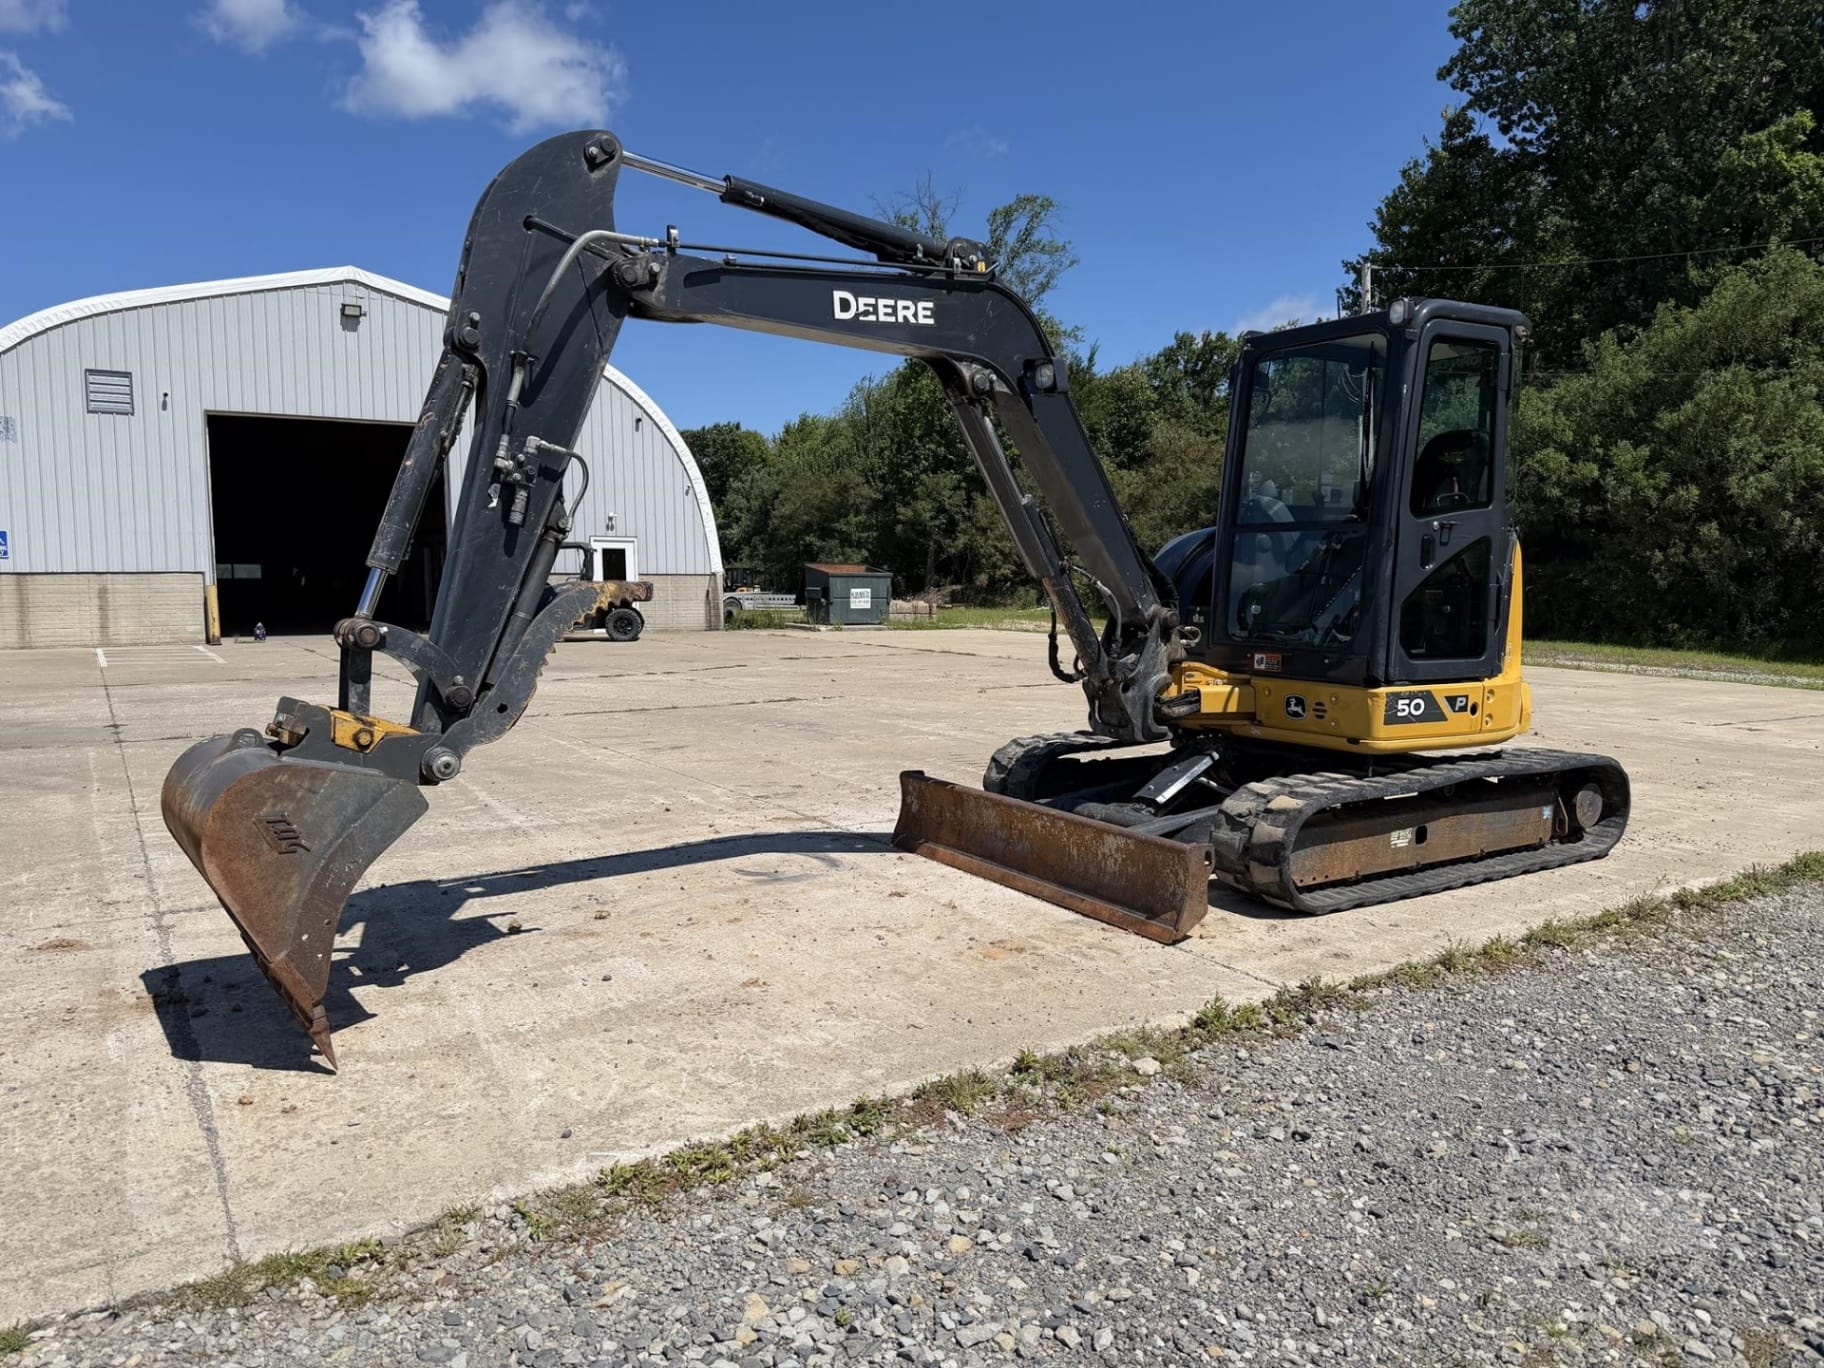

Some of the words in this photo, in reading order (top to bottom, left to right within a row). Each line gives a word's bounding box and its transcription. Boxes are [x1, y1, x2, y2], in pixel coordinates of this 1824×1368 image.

[833, 290, 935, 324] DEERE
[1397, 698, 1425, 716] 50
[1455, 697, 1466, 711] P
